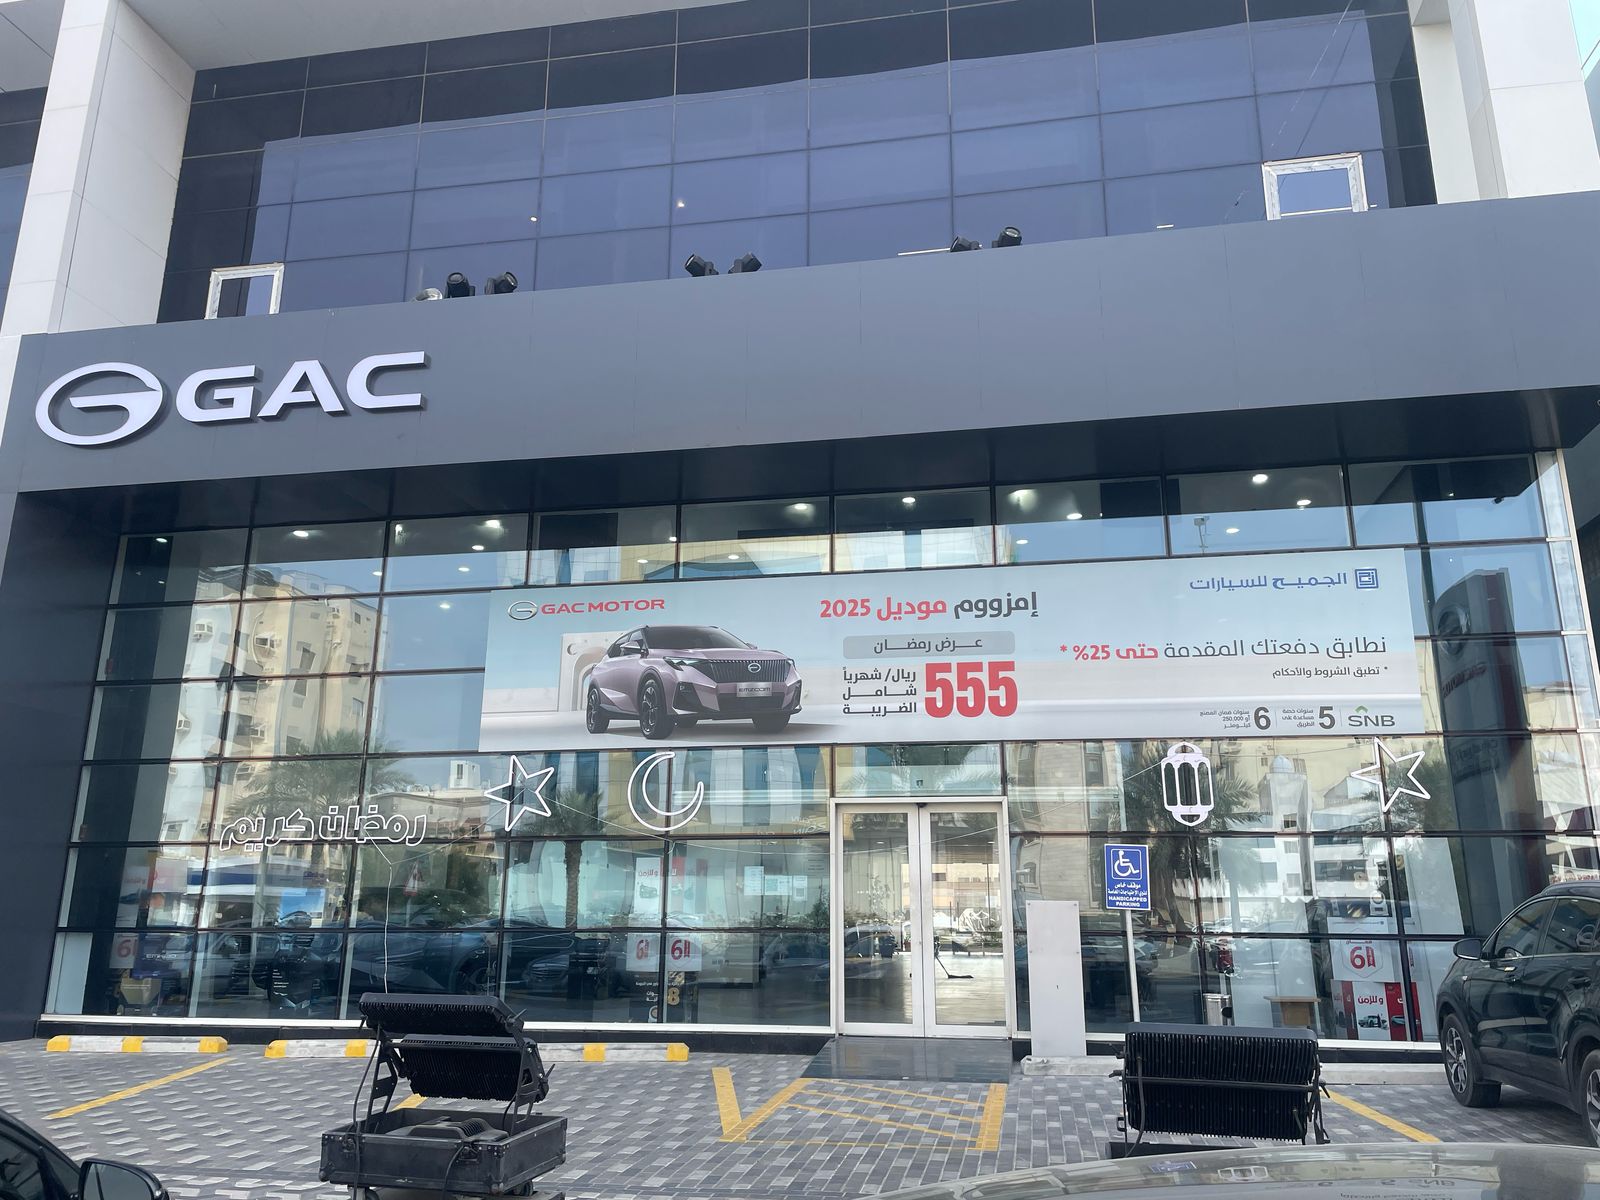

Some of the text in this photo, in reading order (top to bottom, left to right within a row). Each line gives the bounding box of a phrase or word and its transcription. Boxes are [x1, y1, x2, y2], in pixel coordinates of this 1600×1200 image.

[176, 351, 428, 423] GAC
[1189, 572, 1347, 593] الجميح للسيارات
[541, 602, 585, 615] GAC
[587, 599, 665, 613] MOTOR
[820, 591, 1039, 622] إمزووم موديل 2025
[873, 637, 931, 654] رمضان
[1115, 643, 1159, 660] حتى
[1164, 640, 1244, 658] المقدمة
[1251, 638, 1319, 656] دفعتك
[1326, 636, 1387, 659] نطابق
[1272, 666, 1380, 679] تطبق الشروط والأحكام
[842, 684, 917, 700] شامل
[924, 660, 1018, 718] 555
[842, 702, 917, 717] الضريبة
[1254, 706, 1271, 730] 6
[1319, 706, 1336, 730] 5
[1347, 715, 1395, 727] SNB
[220, 804, 426, 851] رمضان كريم
